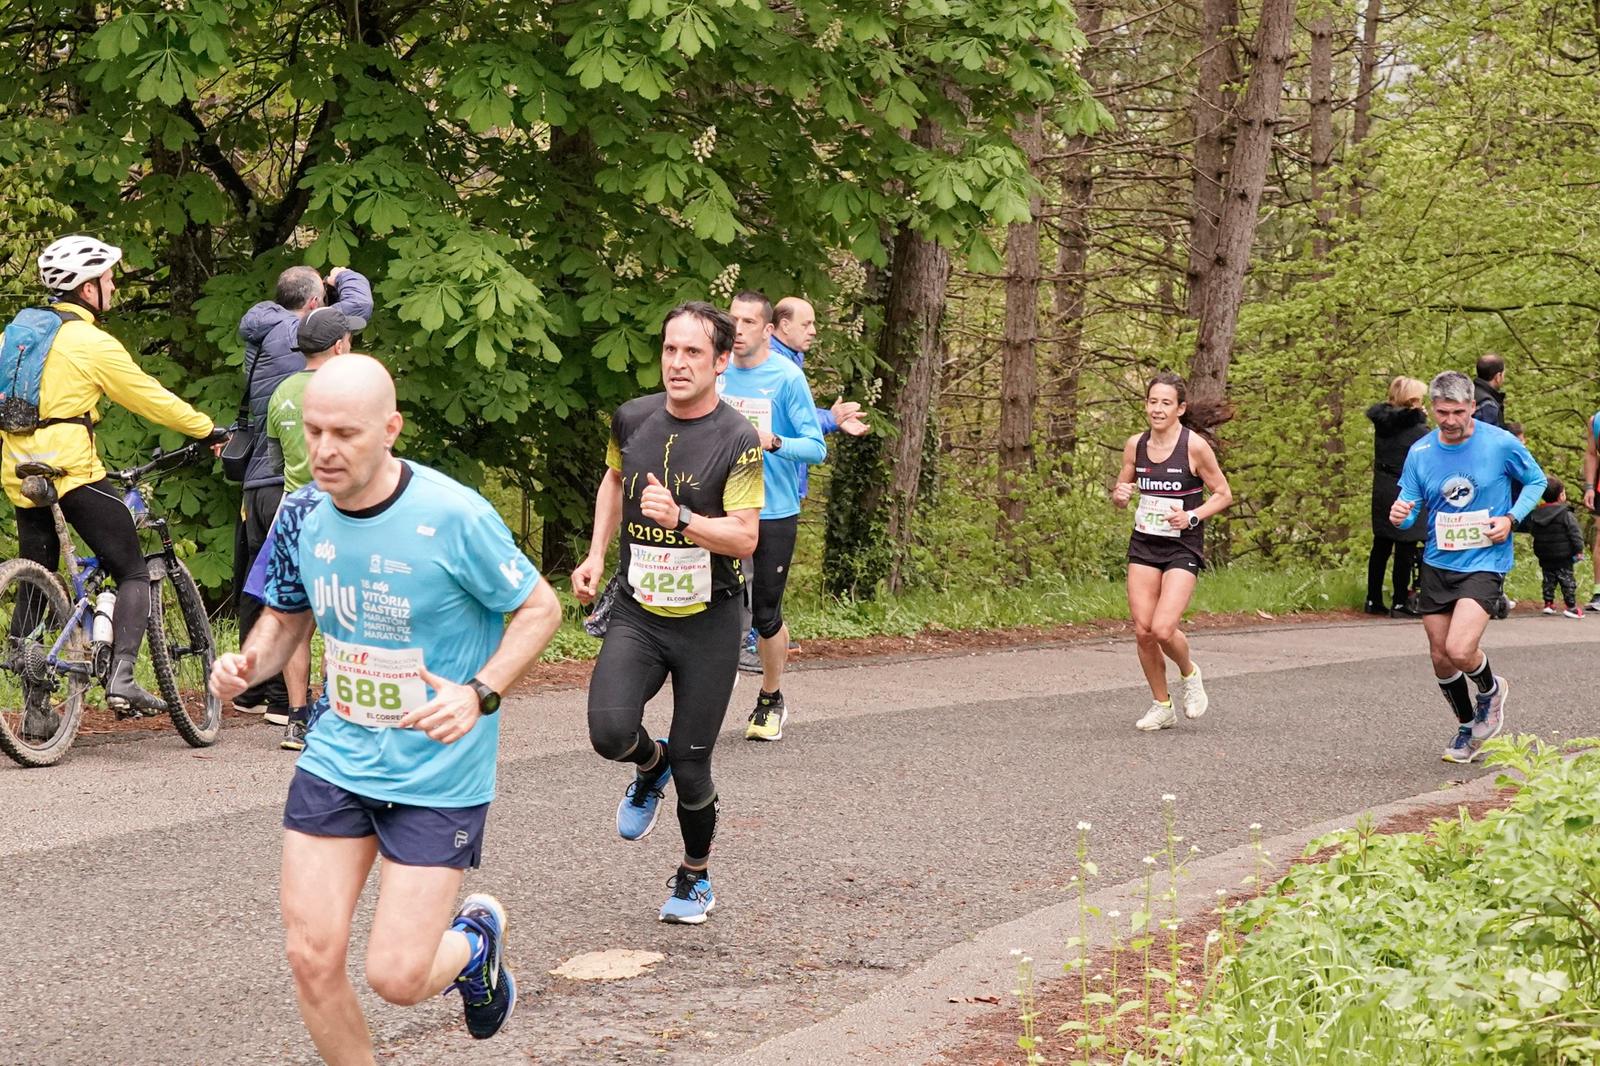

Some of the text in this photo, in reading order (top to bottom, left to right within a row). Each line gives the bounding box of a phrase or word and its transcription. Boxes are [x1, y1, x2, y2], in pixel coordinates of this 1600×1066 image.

[1445, 527, 1480, 541] 443
[314, 539, 336, 564] edp
[640, 572, 695, 593] 424
[362, 590, 411, 609] VITORIA
[362, 602, 411, 619] GASTEIZ
[326, 638, 368, 666] Vital
[336, 674, 402, 710] 688
